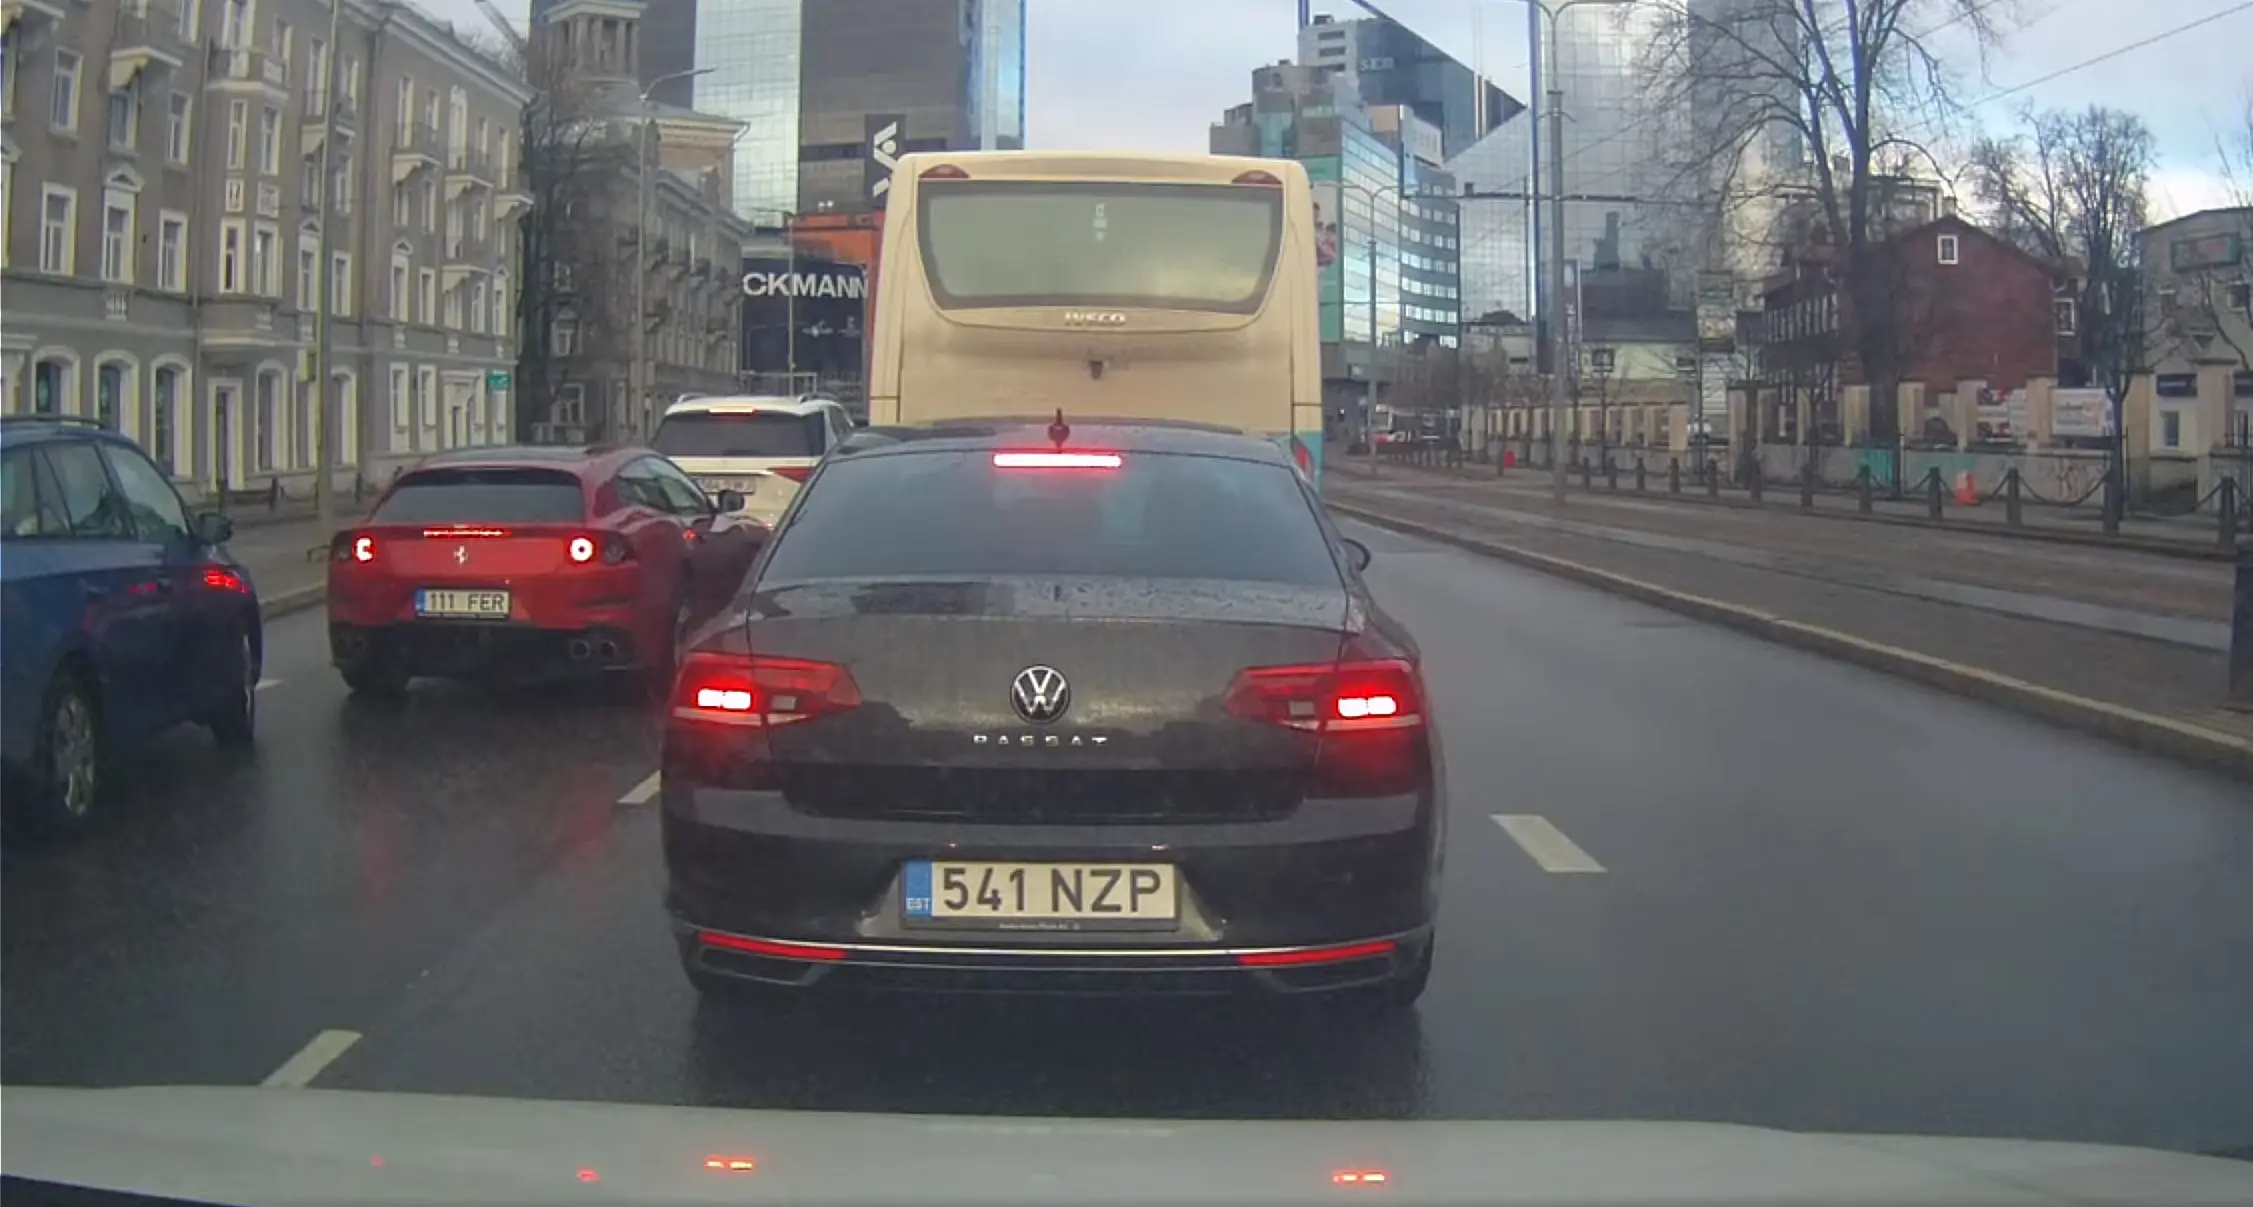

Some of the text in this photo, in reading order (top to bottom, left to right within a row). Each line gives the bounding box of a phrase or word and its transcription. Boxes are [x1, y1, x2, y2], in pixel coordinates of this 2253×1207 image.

[430, 593, 505, 611] 111 FER
[973, 735, 1108, 747] PASSAT
[942, 867, 1162, 913] 541 NZP
